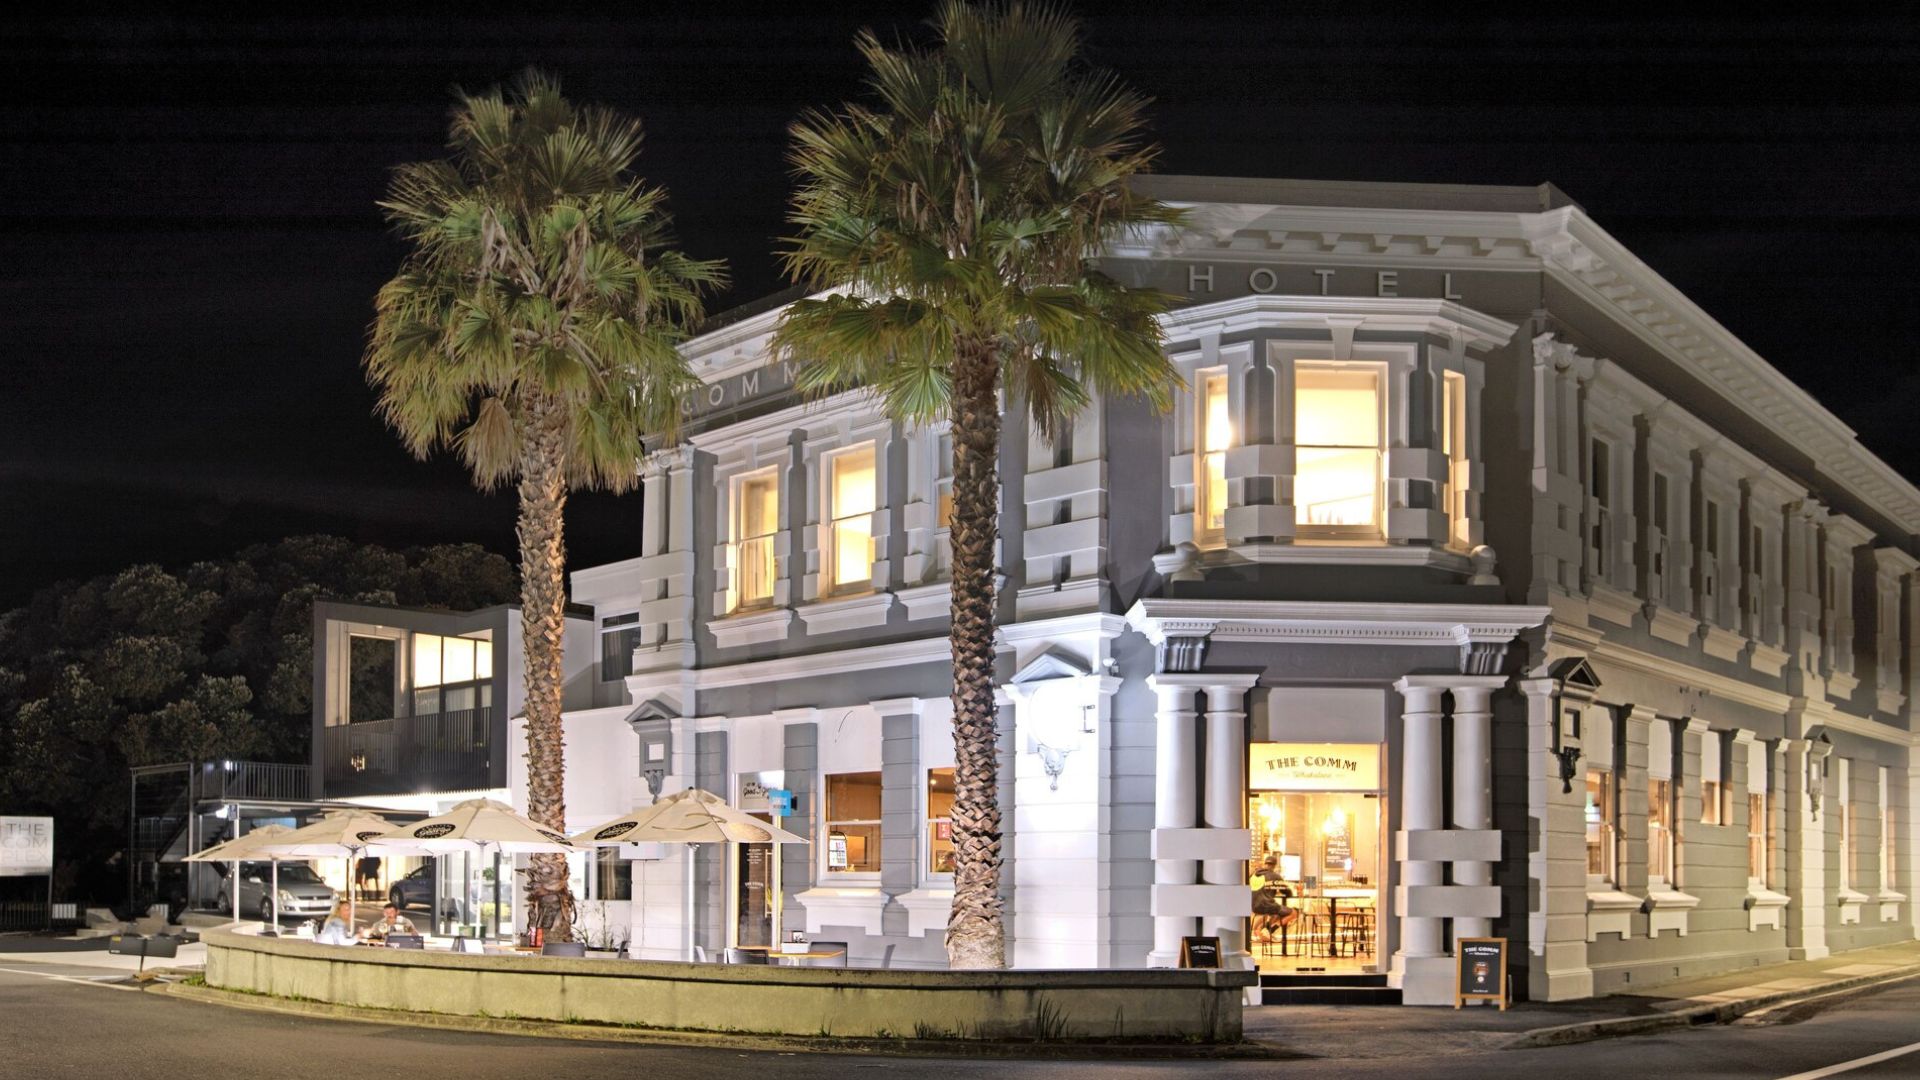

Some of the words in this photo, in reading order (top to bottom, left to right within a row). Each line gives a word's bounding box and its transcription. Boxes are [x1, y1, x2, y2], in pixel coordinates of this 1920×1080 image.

[1188, 264, 1462, 300] HOTEL
[1266, 757, 1299, 770] THE
[1303, 756, 1357, 771] COMM
[6, 823, 45, 835] THE
[2, 837, 48, 849] COM
